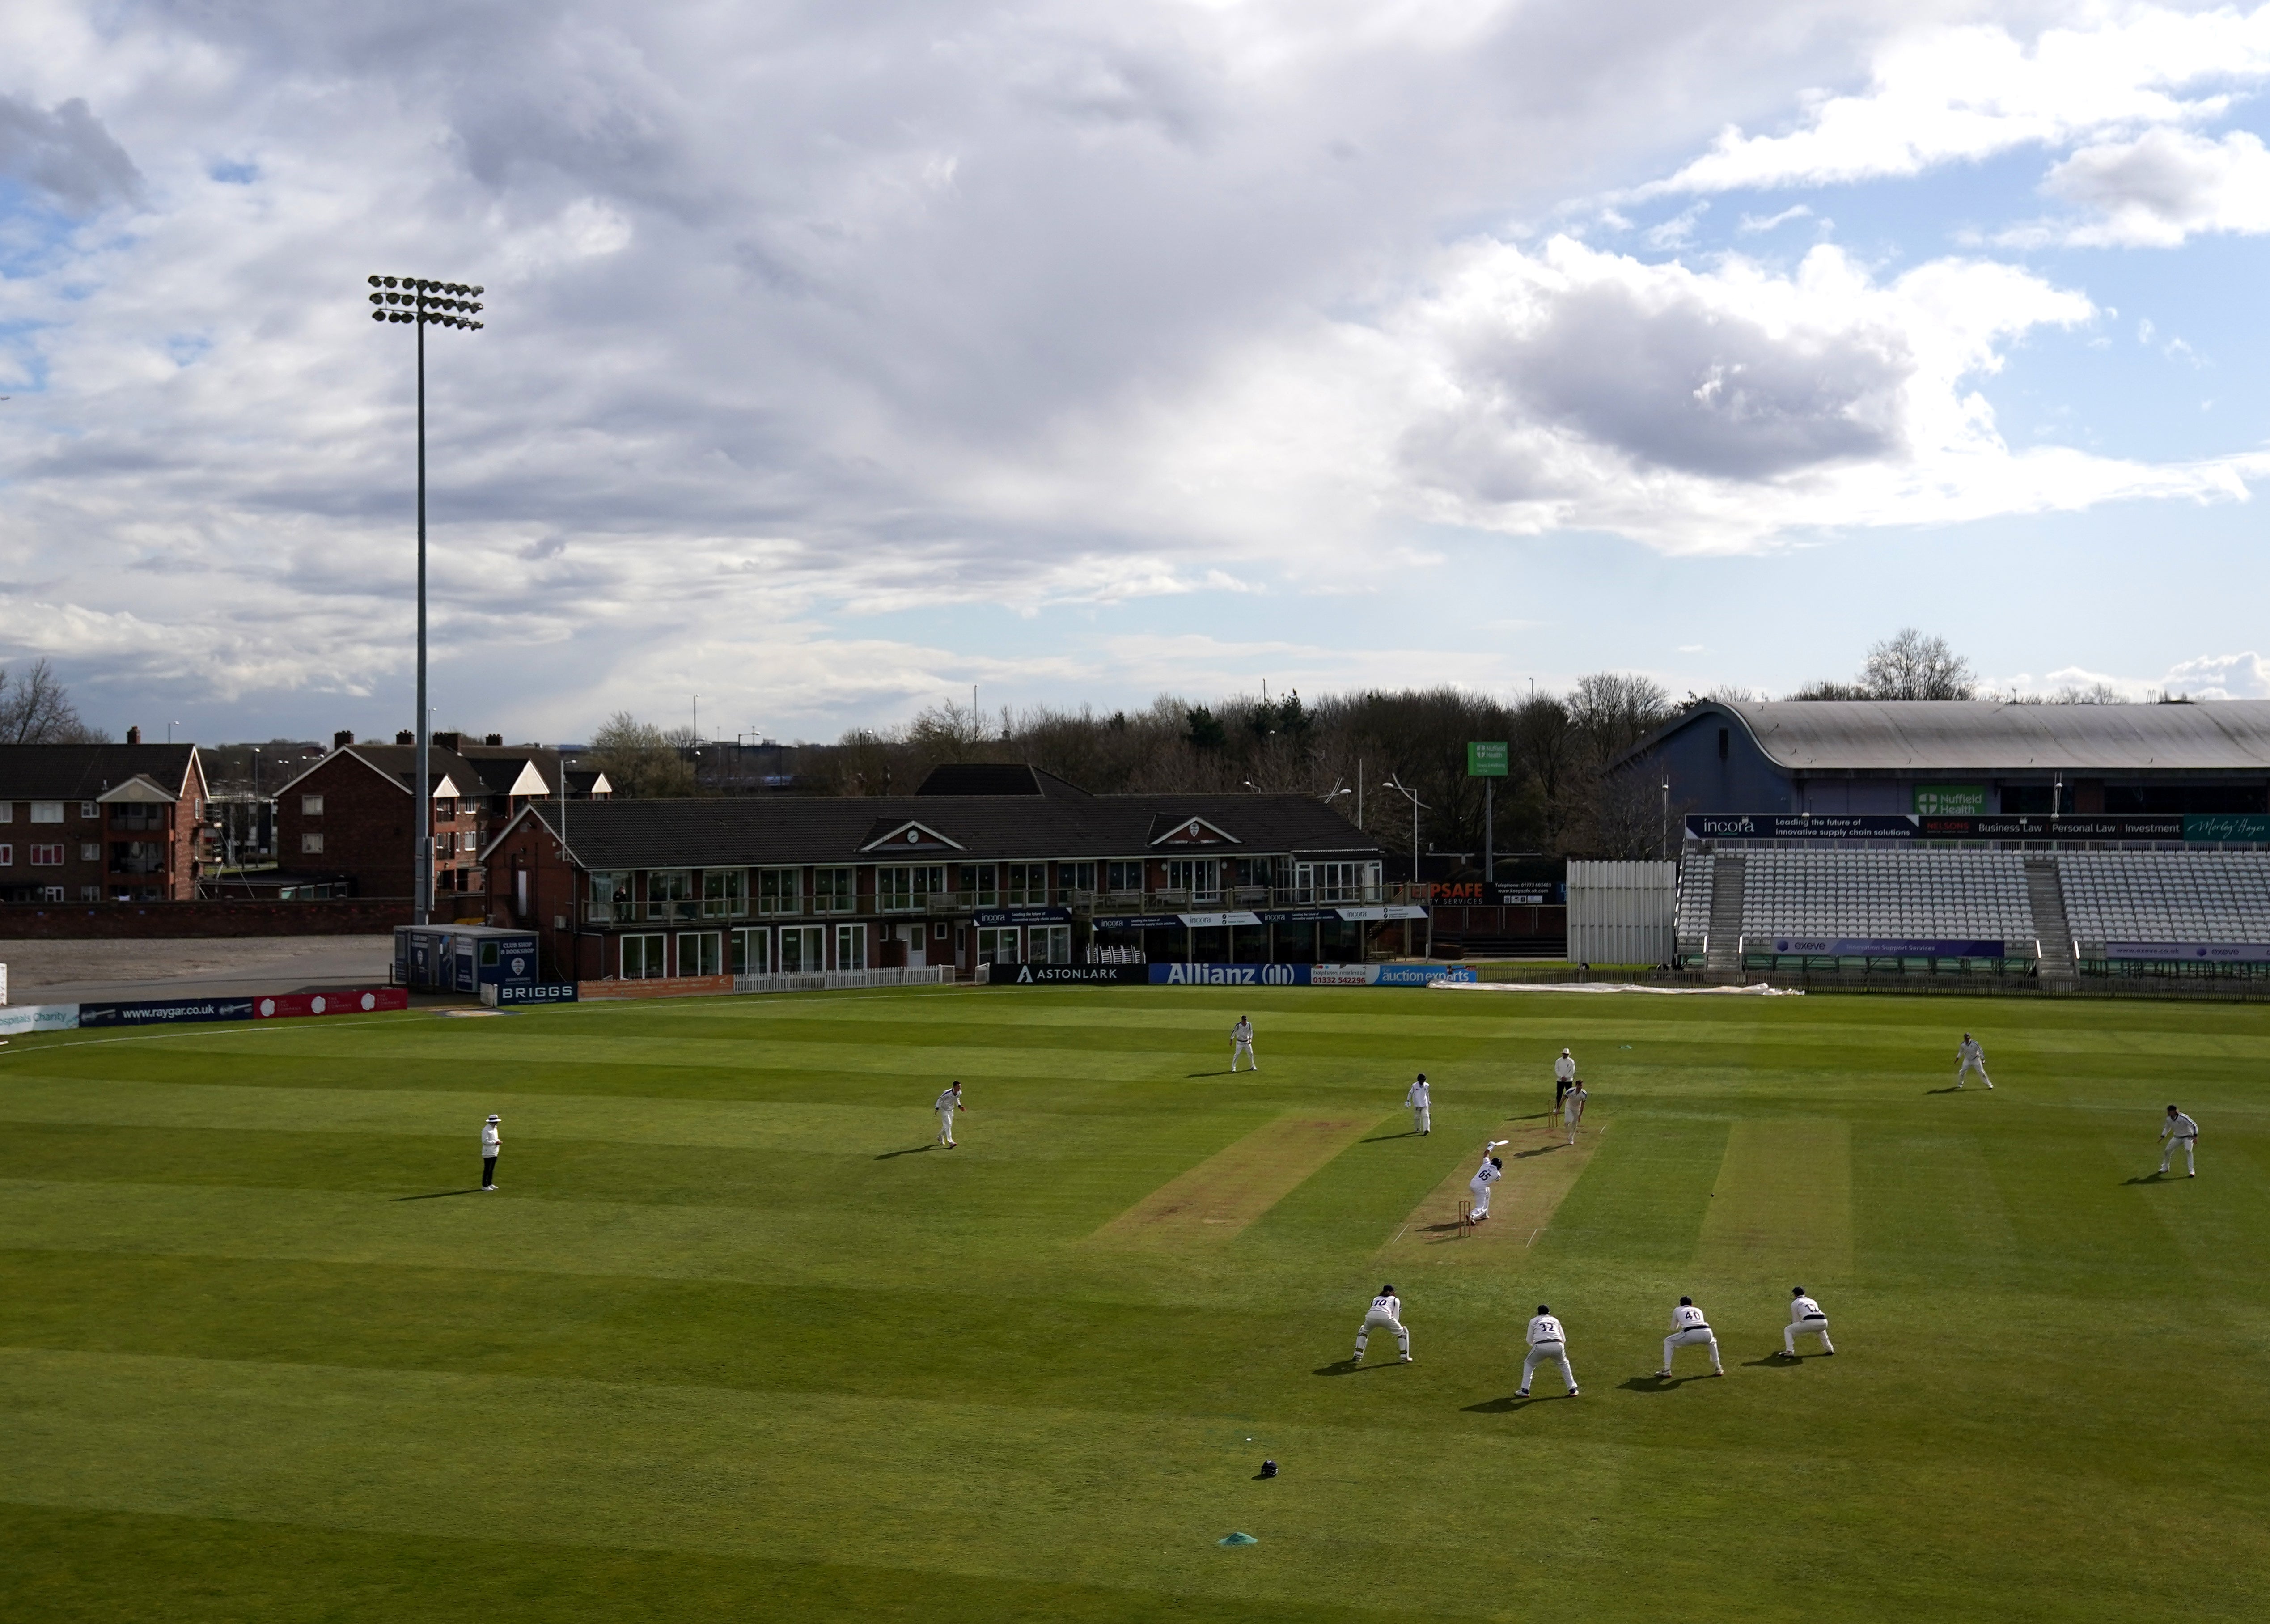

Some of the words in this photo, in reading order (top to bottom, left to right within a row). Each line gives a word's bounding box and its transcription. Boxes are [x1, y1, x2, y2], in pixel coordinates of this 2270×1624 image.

[1940, 793, 1982, 804] Nuffield
[1940, 805, 1975, 814] Health
[1703, 818, 1755, 833] incora
[1775, 818, 1809, 827] Leading
[1811, 818, 1825, 826] the
[1826, 818, 1850, 826] future
[1852, 818, 1862, 826] of
[1927, 822, 1969, 830] NELSONS
[1978, 822, 2021, 833] Business
[2023, 823, 2043, 833] Law
[2052, 823, 2093, 833] Personal
[2096, 823, 2117, 833] Law
[2125, 823, 2181, 833] Investment
[1819, 827, 1847, 838] supply
[1849, 828, 1872, 836] chain
[1873, 828, 1911, 837] solutions
[982, 913, 1005, 922] incora
[1264, 913, 1286, 921] incora
[1347, 910, 1367, 918] incora
[1101, 919, 1123, 927] incora
[2211, 948, 2240, 956] exeve
[1037, 969, 1117, 979] ASTONLARK
[1167, 963, 1256, 985] Allianz
[1382, 969, 1423, 982] auction
[1425, 971, 1469, 982] experts
[502, 986, 572, 999] BRIGGS
[122, 1004, 215, 1019] www.raygar.co.uk
[1479, 1170, 1492, 1181] 65
[1685, 1311, 1700, 1320] 40
[1539, 1323, 1555, 1332] 32
